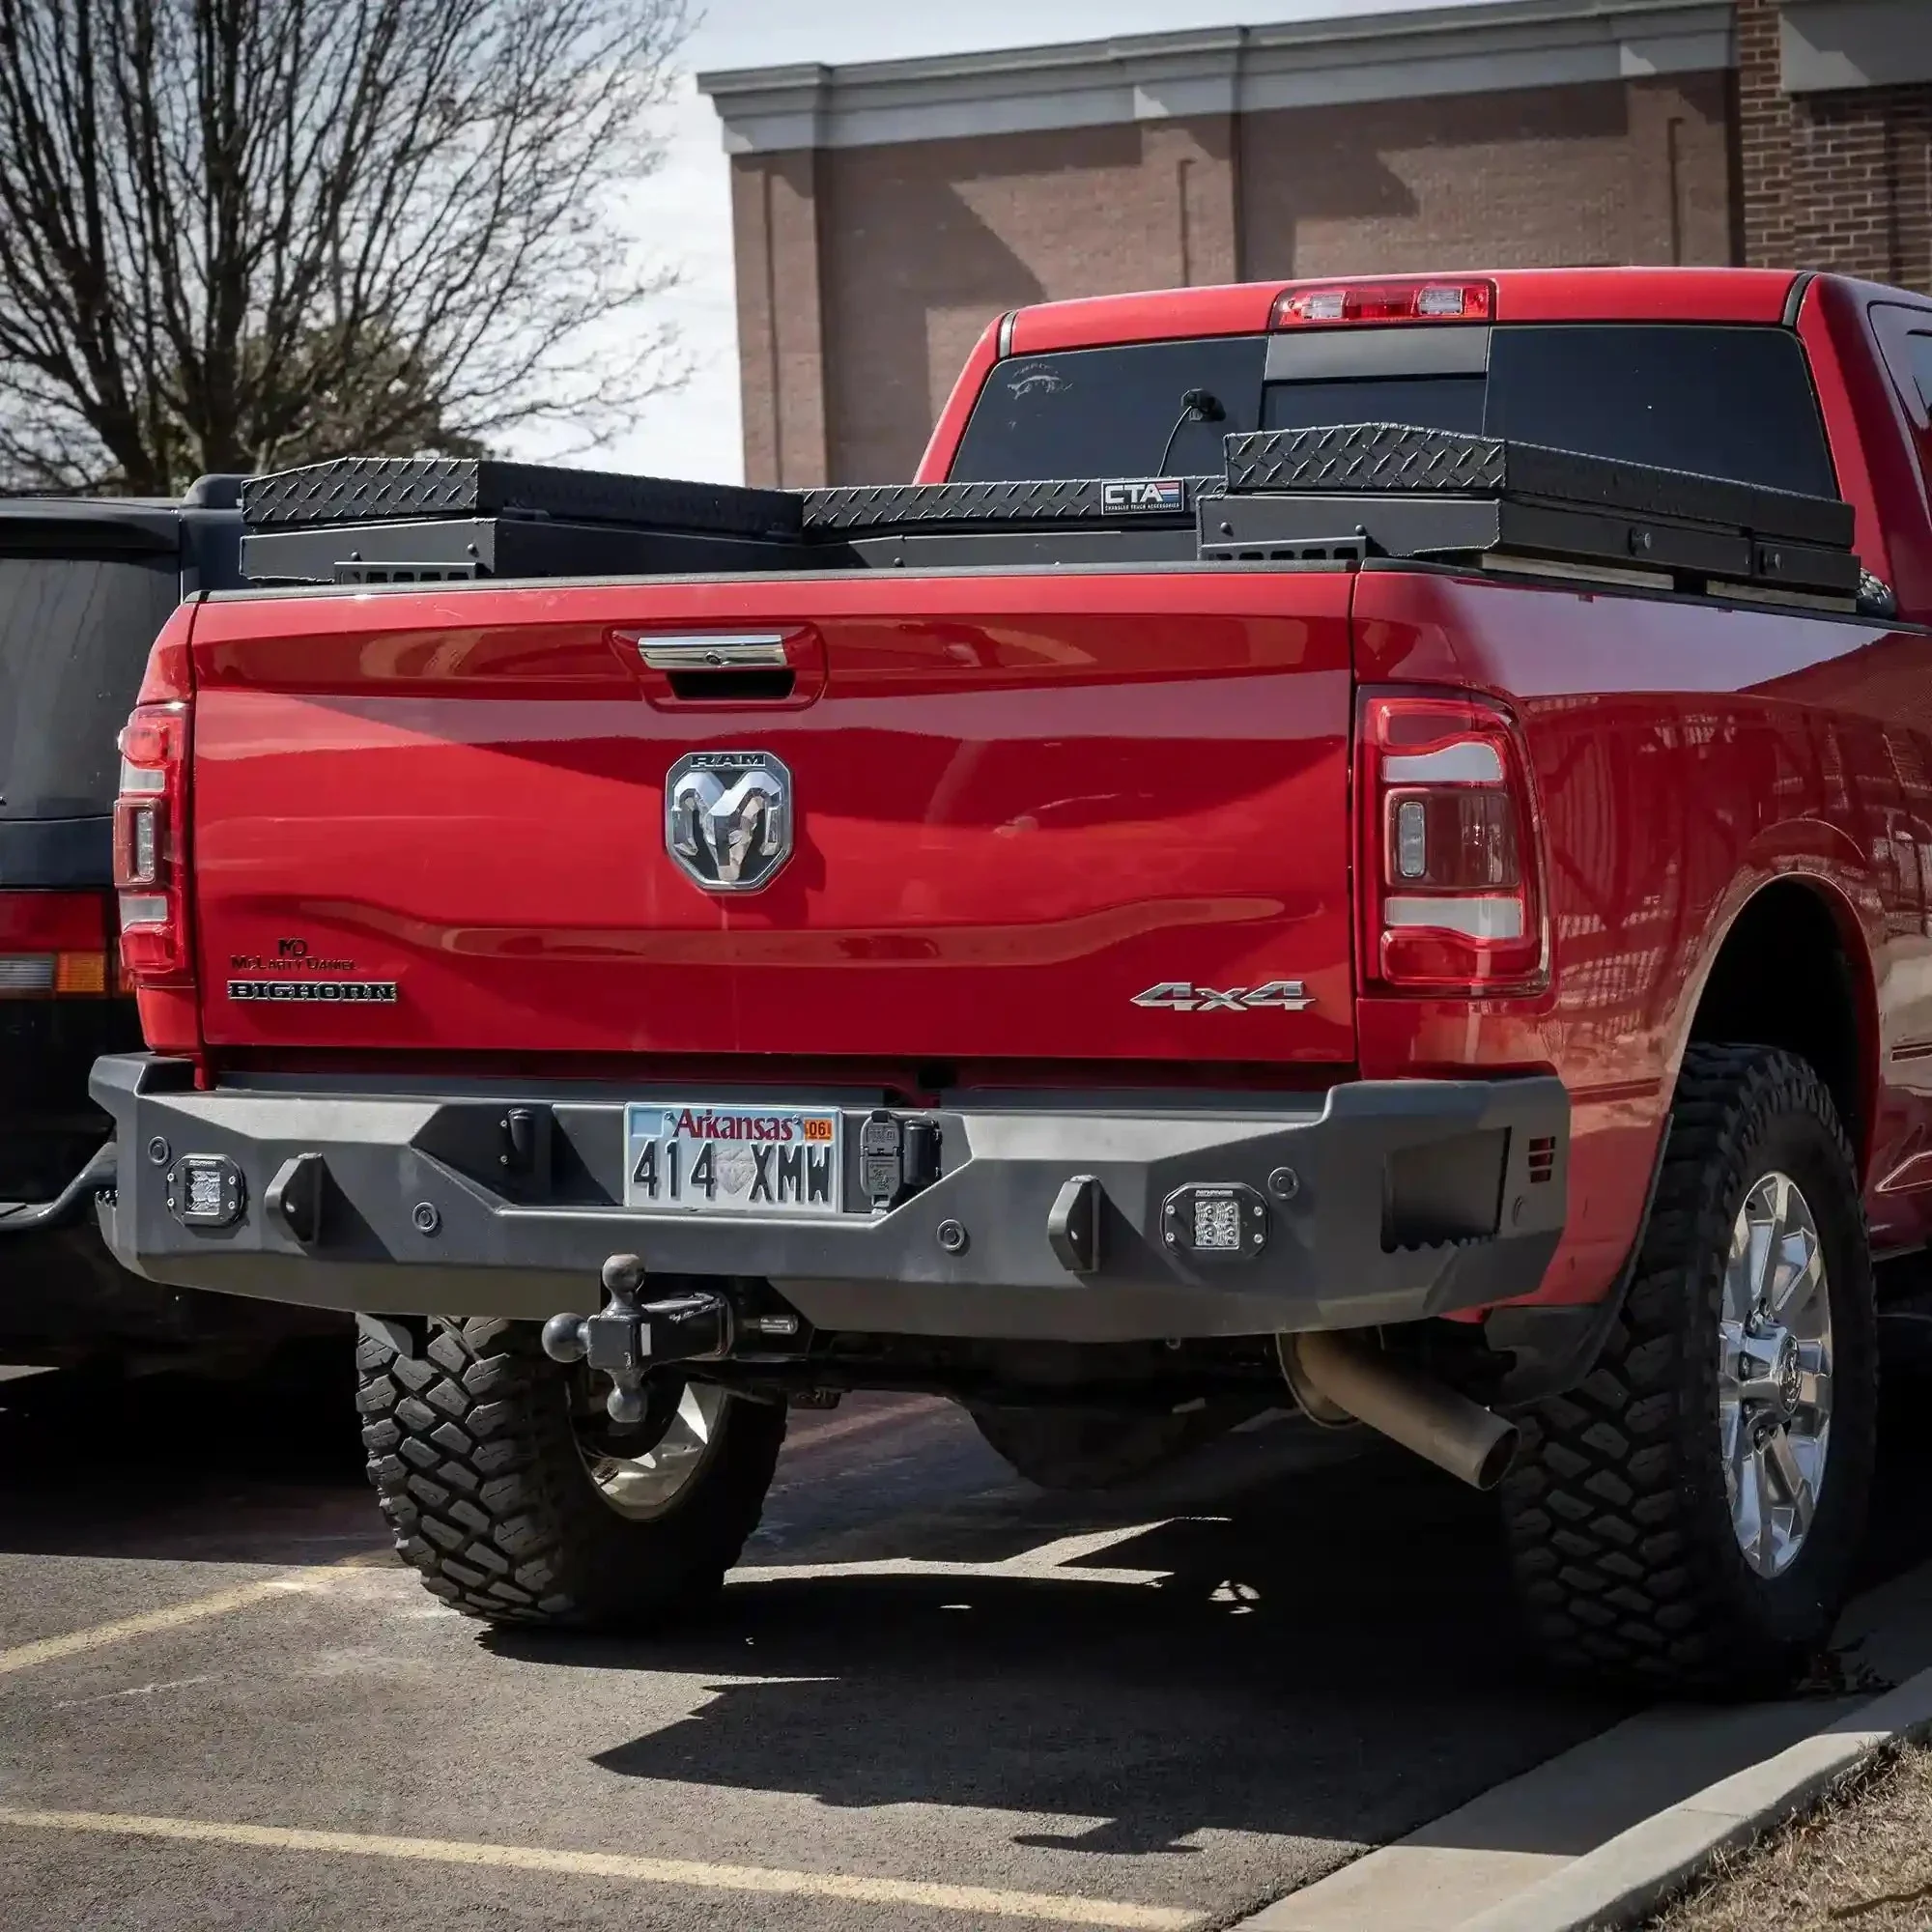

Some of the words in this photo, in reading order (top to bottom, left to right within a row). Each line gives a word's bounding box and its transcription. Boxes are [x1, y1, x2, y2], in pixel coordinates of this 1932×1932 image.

[1105, 483, 1163, 503] CTA
[691, 754, 766, 767] RAM
[227, 980, 398, 1002] BIGHORN
[672, 1108, 793, 1141] Arkansas
[810, 1122, 826, 1136] 06
[633, 1139, 718, 1199] 414
[748, 1143, 832, 1203] XMW
